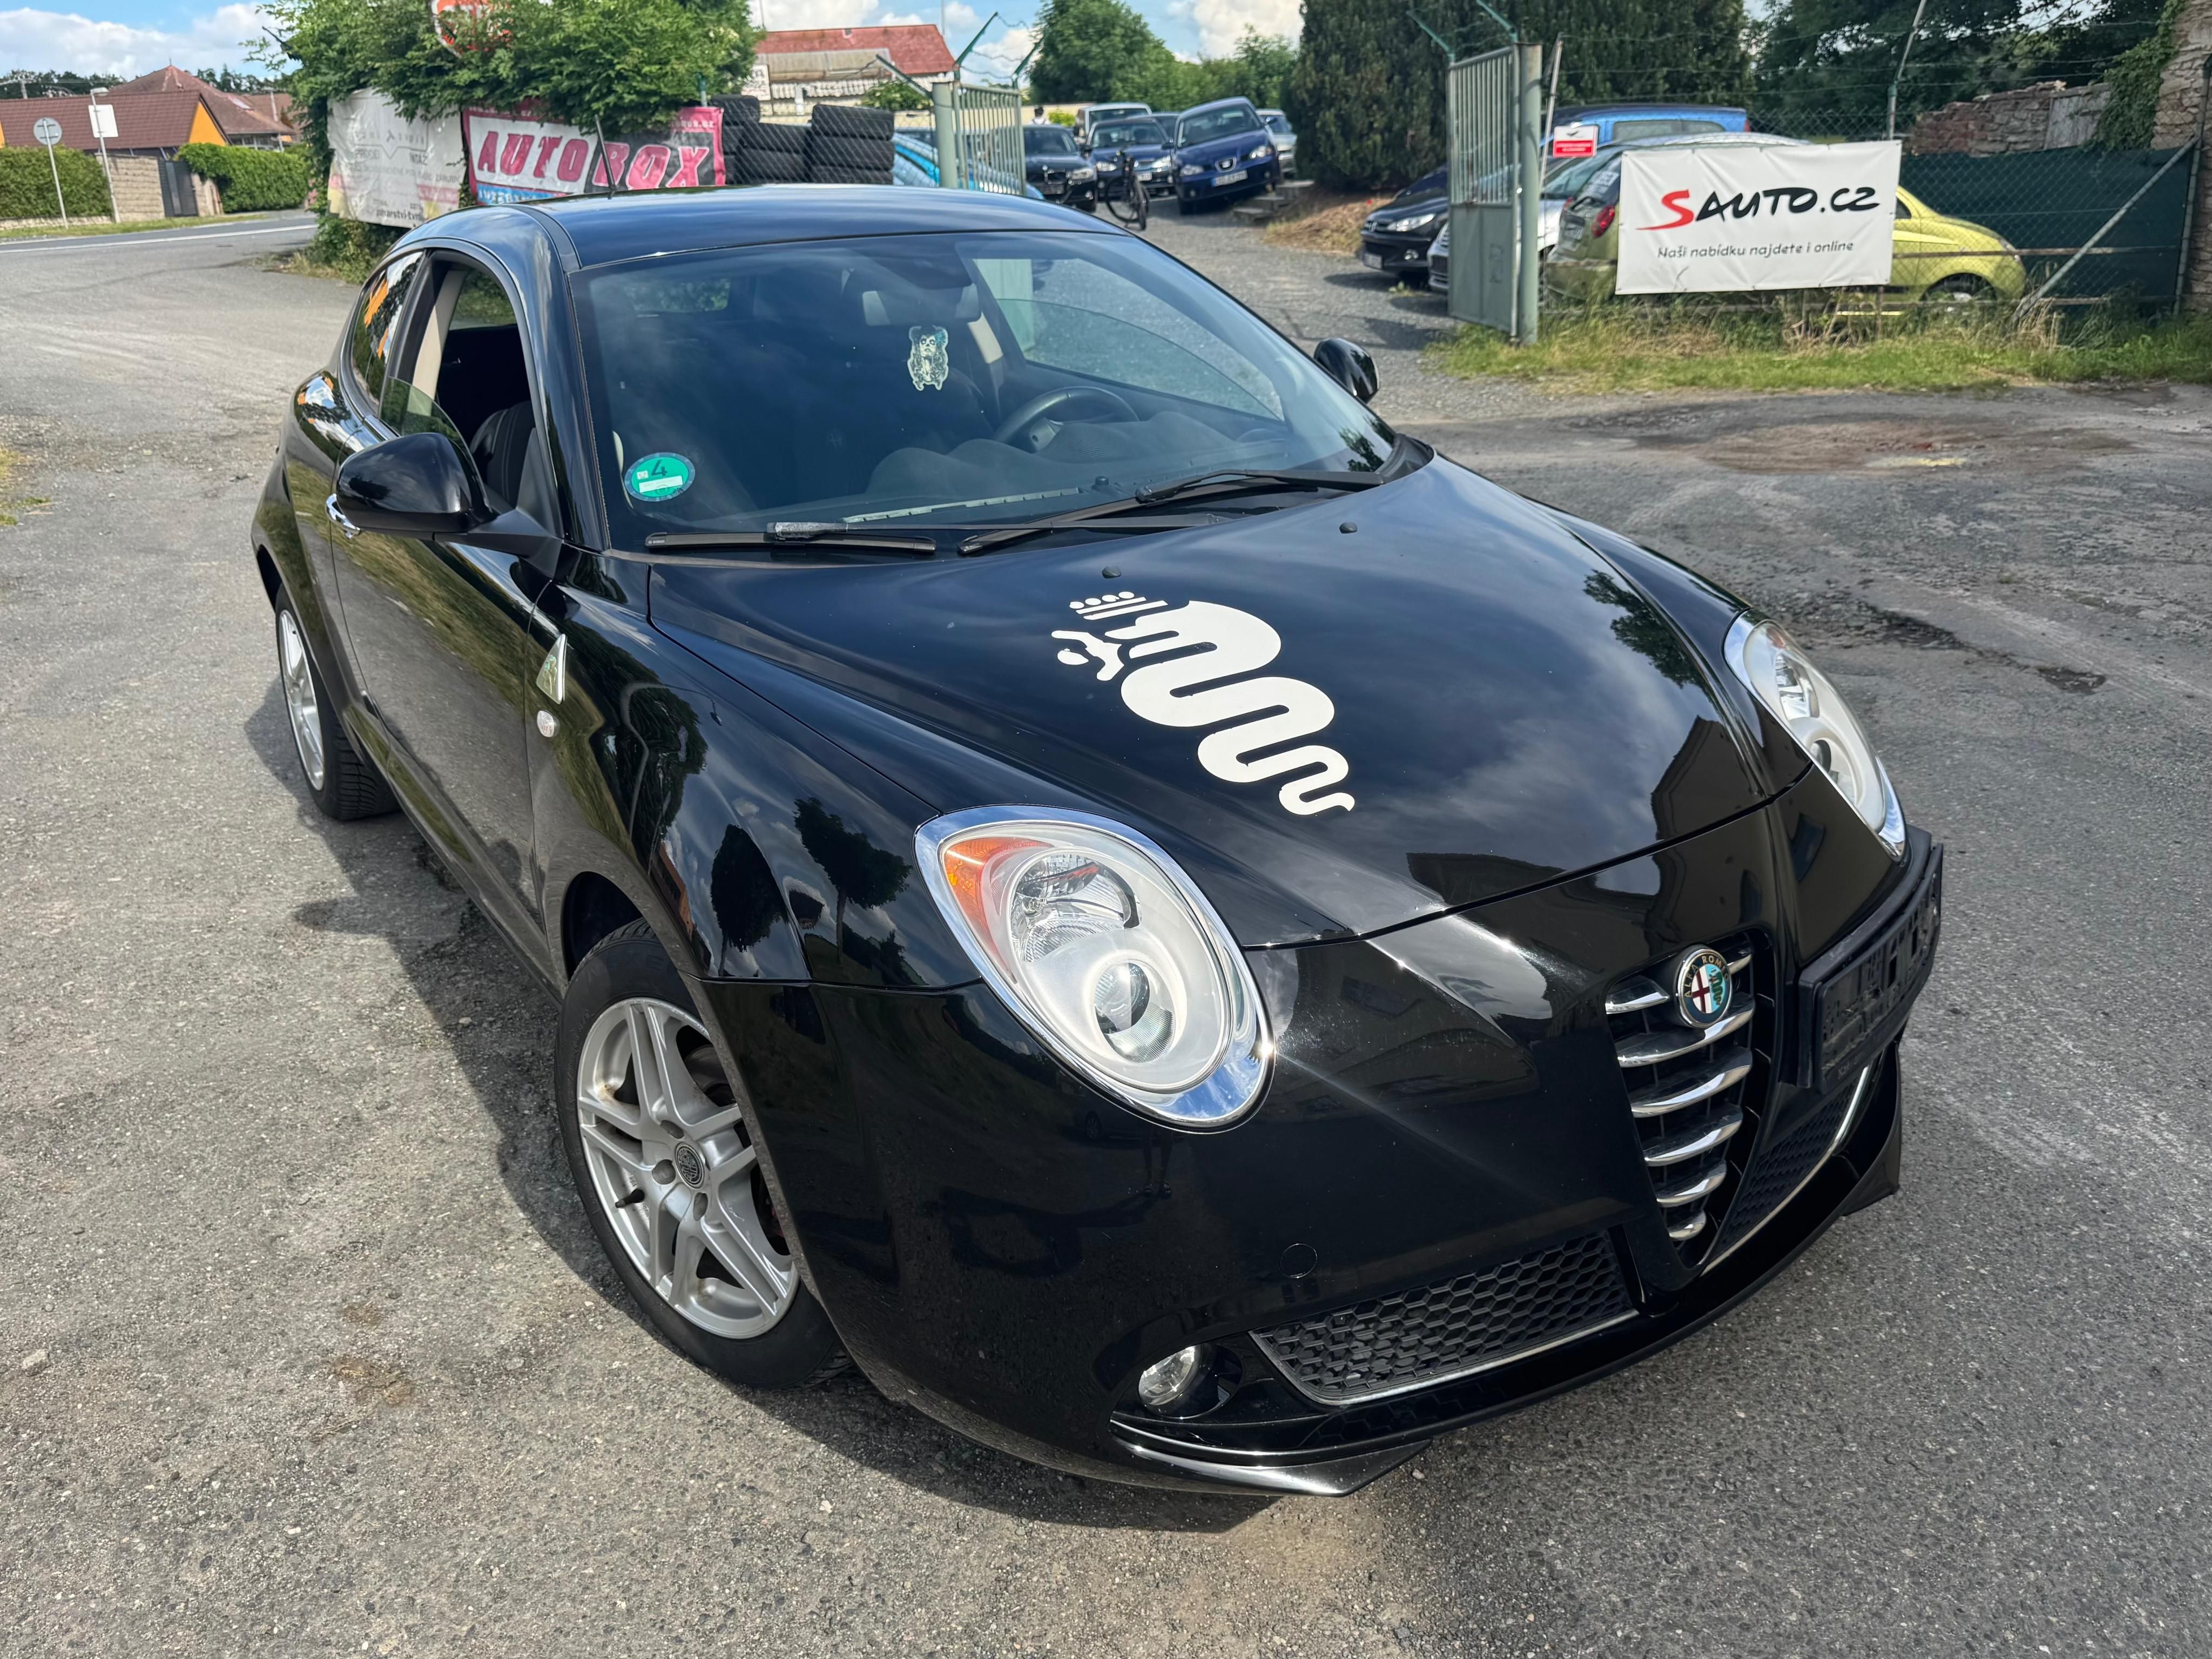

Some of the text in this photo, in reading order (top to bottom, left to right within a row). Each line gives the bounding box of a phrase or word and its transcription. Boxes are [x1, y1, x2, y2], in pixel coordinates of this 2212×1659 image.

[1657, 240, 1854, 258] Naši nabídku najdete i online
[651, 460, 667, 476] 4
[1684, 955, 1729, 997] ALFA ROMEO
